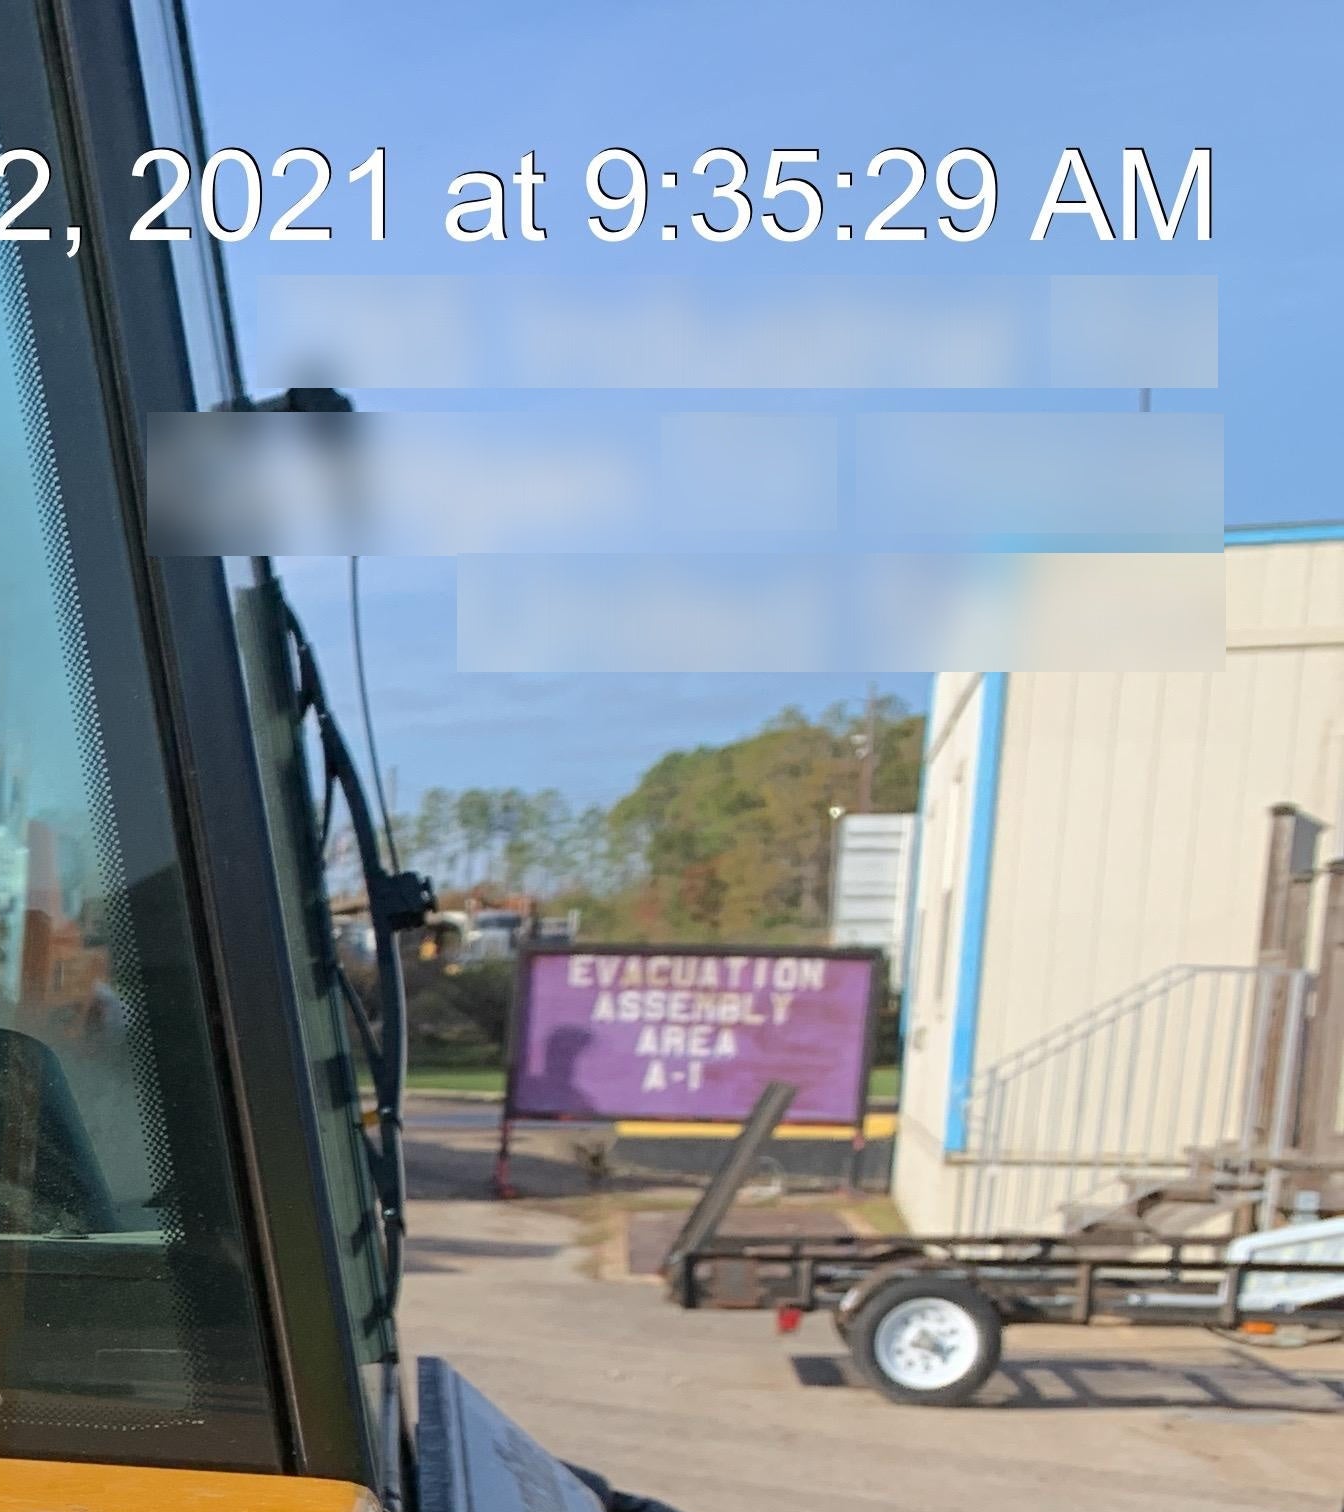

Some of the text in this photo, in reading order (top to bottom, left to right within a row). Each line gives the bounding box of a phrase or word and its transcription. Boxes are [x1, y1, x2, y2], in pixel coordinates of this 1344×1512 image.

[567, 953, 826, 992] EVACUATION
[591, 989, 796, 1025] ASSEMBLY
[634, 1024, 738, 1058] AREA
